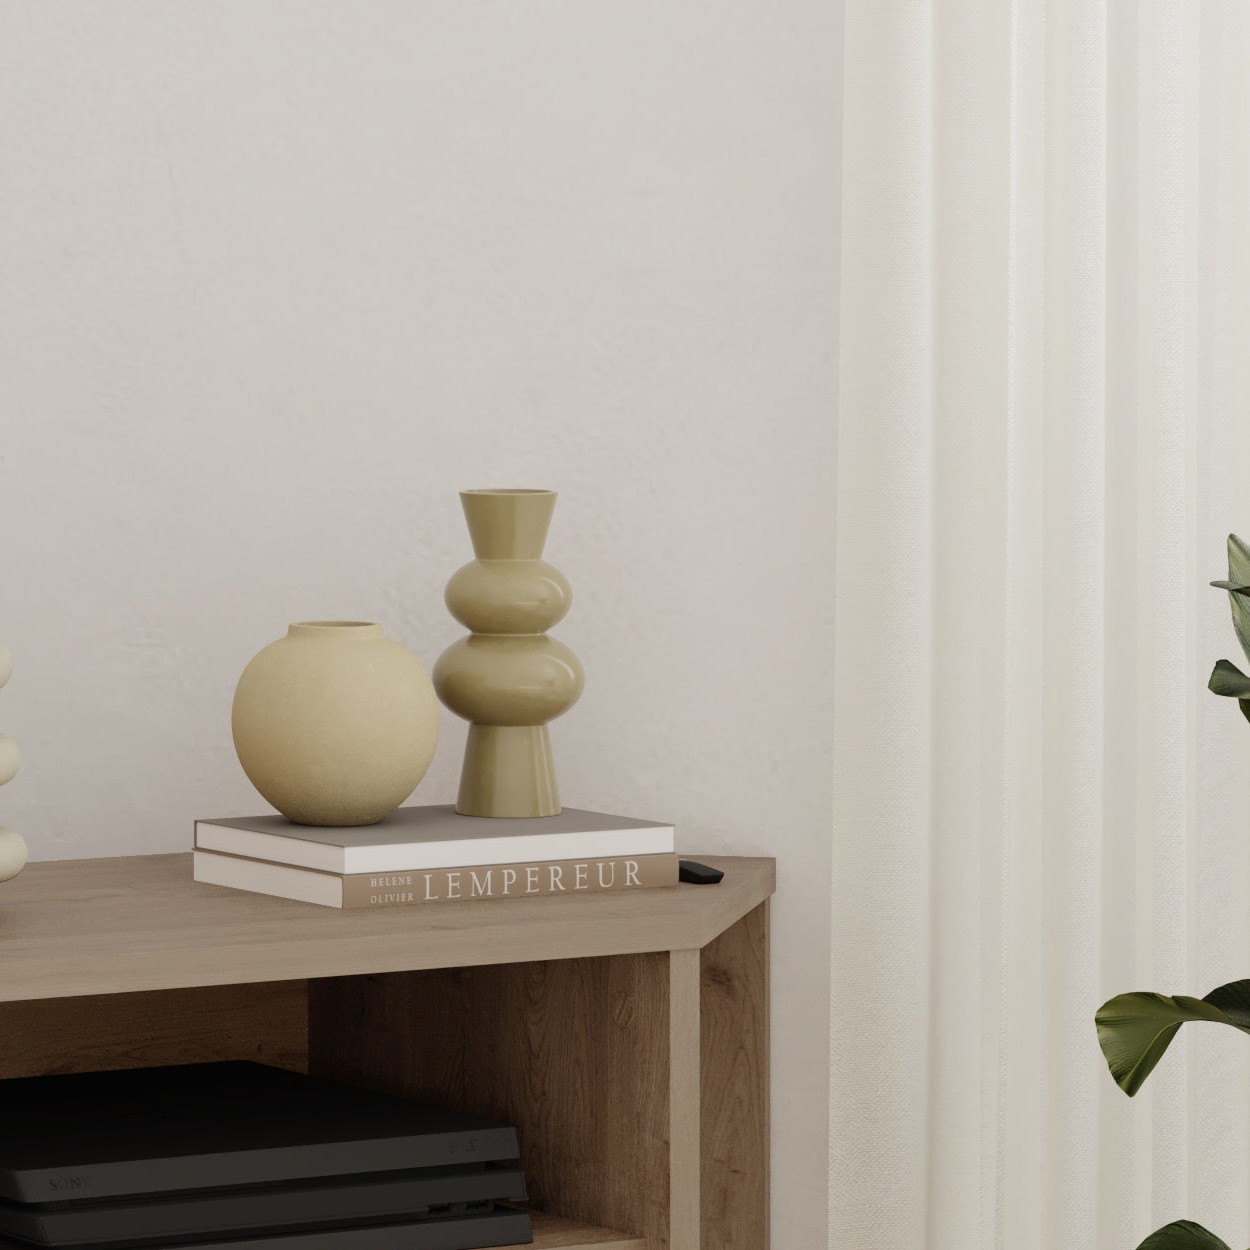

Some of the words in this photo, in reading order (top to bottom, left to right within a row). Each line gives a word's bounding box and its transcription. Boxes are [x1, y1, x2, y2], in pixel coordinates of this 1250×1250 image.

[370, 875, 414, 888] HELENE
[423, 860, 643, 901] LEMPEREUR
[370, 892, 414, 904] OLIVIER
